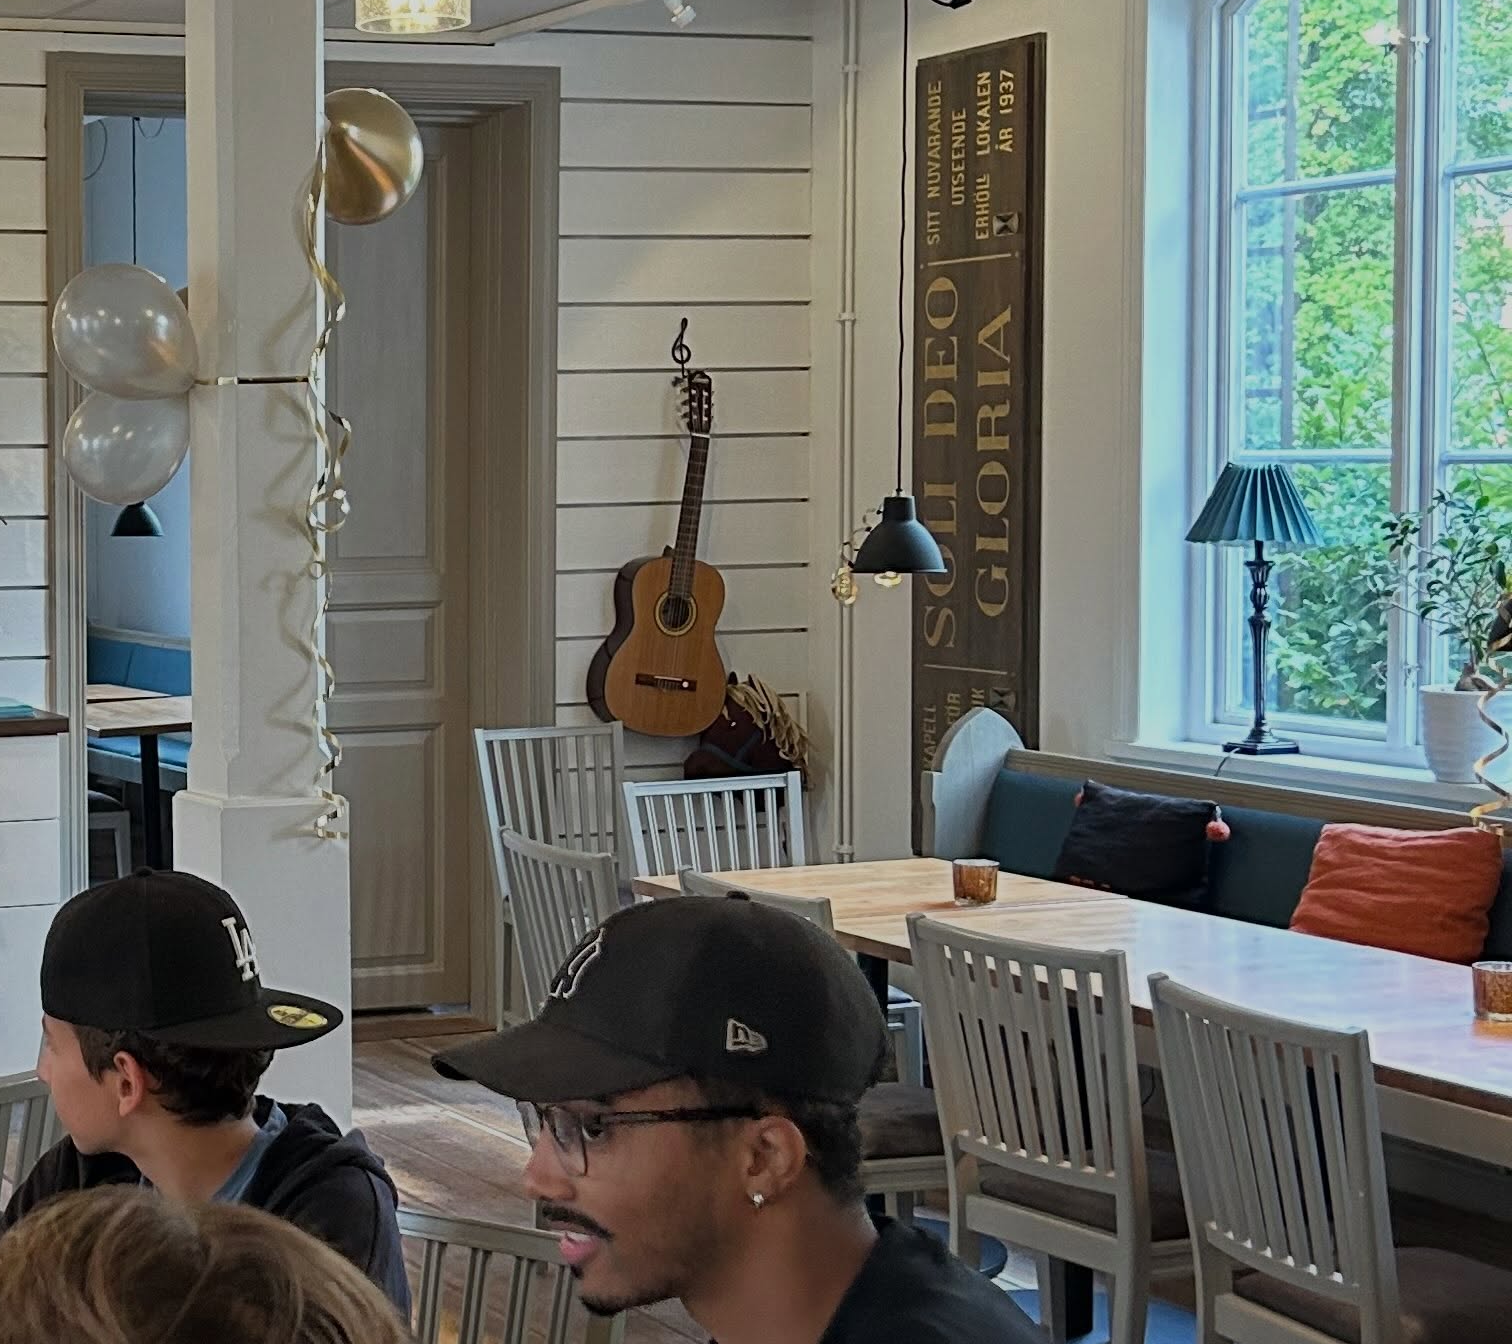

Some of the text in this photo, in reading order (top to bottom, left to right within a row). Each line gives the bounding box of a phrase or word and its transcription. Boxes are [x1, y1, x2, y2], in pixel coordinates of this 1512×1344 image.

[927, 79, 942, 246] SITT NUVARANDE
[951, 107, 967, 206] UTSEENDE
[973, 71, 991, 241] ERHÖLL LOKALEN
[995, 69, 1015, 153] ÅR 1937
[923, 275, 959, 649] SOLI DEO
[974, 304, 1013, 618] GLORIA
